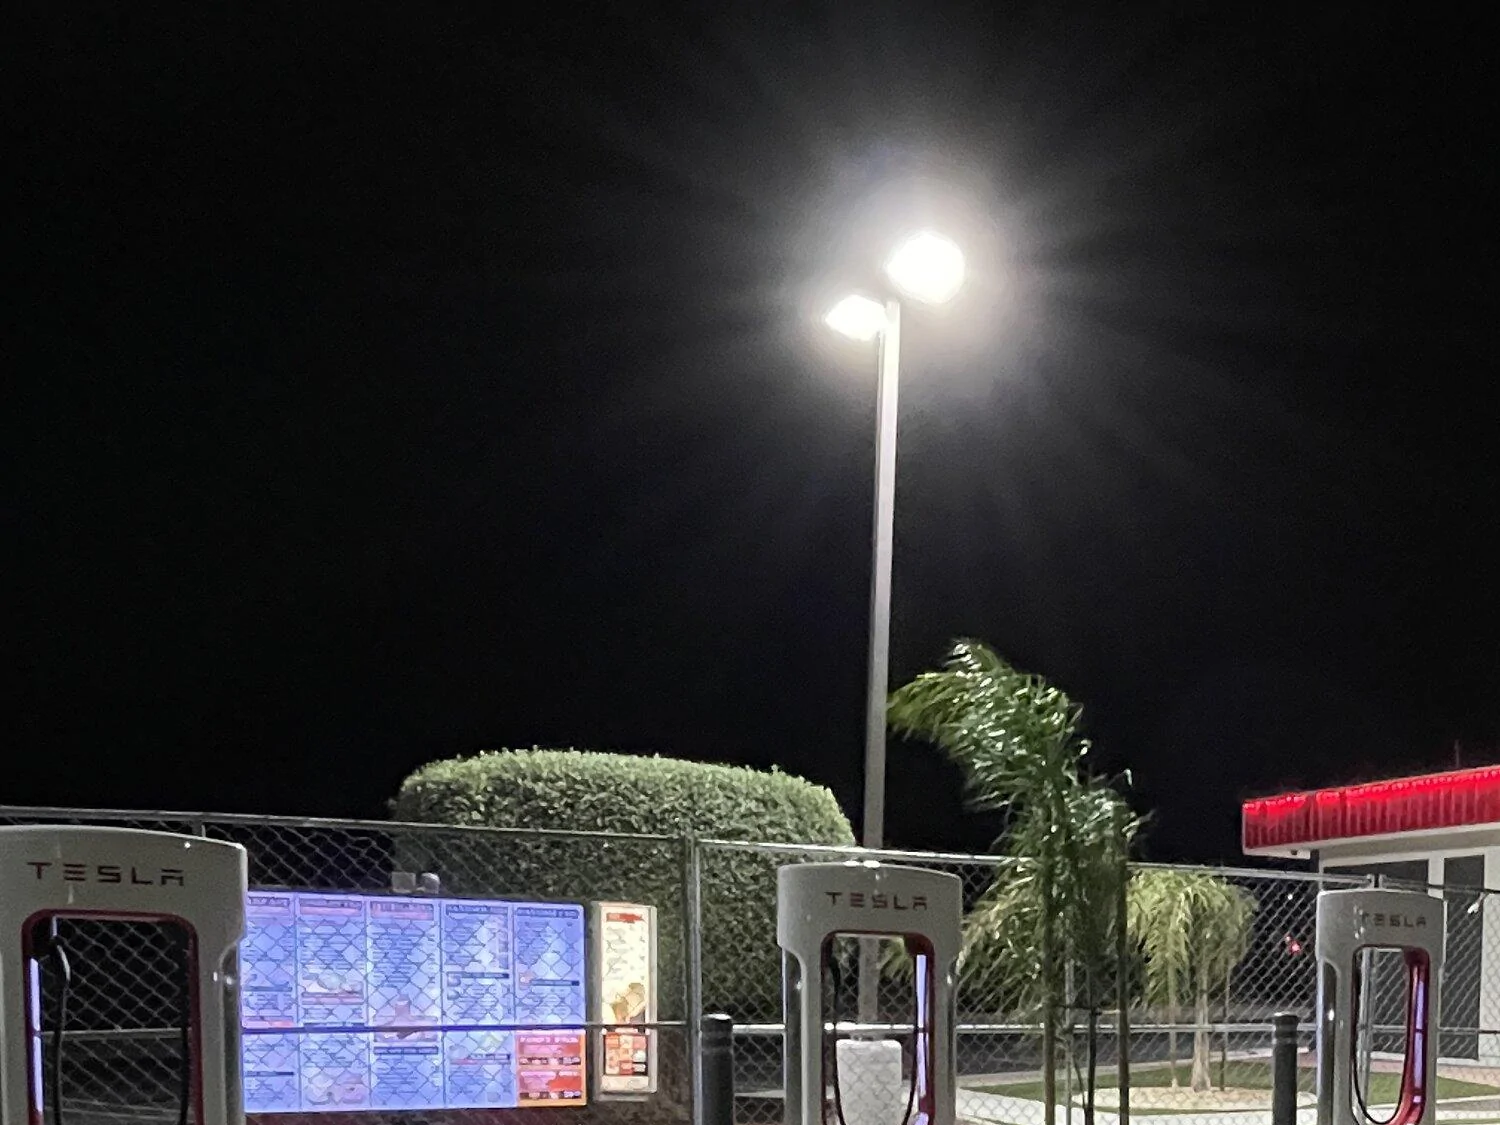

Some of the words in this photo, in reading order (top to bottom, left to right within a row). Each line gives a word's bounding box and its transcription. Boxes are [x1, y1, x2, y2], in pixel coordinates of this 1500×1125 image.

[27, 862, 184, 886] TESLA
[825, 891, 928, 911] TESLA
[1361, 912, 1427, 928] TESLA
